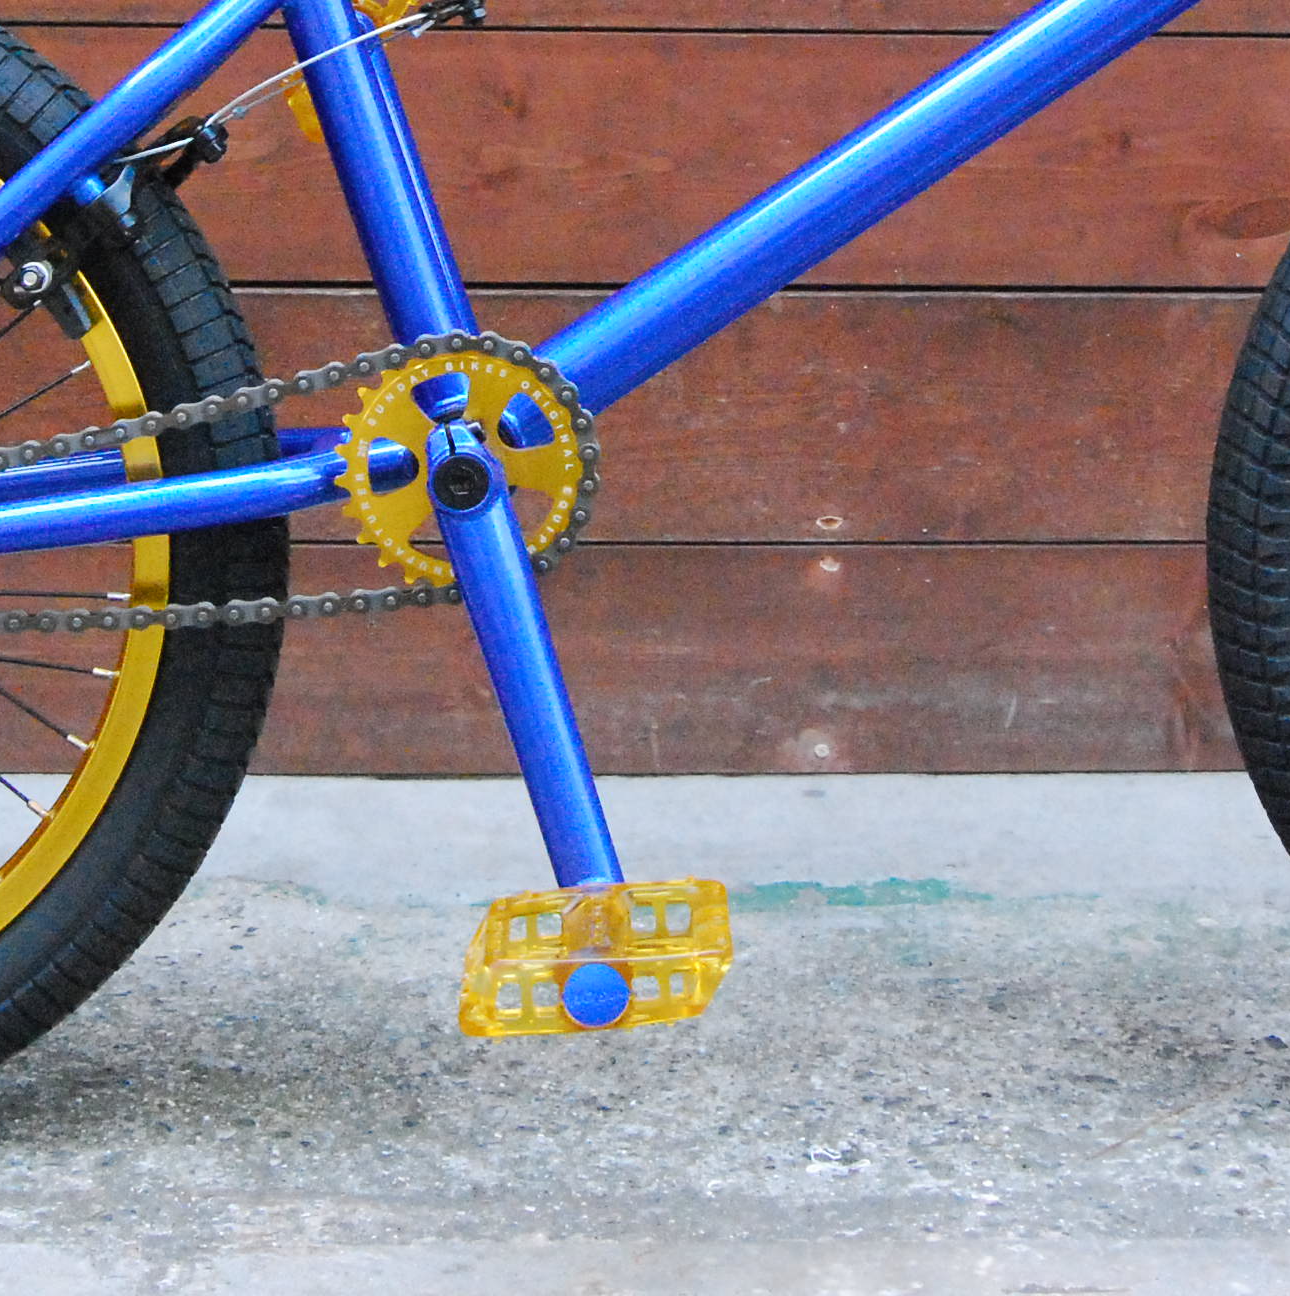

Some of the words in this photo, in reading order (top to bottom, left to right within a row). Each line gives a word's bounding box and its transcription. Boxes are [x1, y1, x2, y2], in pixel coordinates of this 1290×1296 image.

[367, 368, 429, 426] SUNDAY
[445, 360, 507, 378] BIKES
[521, 381, 574, 471] ORIGINAL
